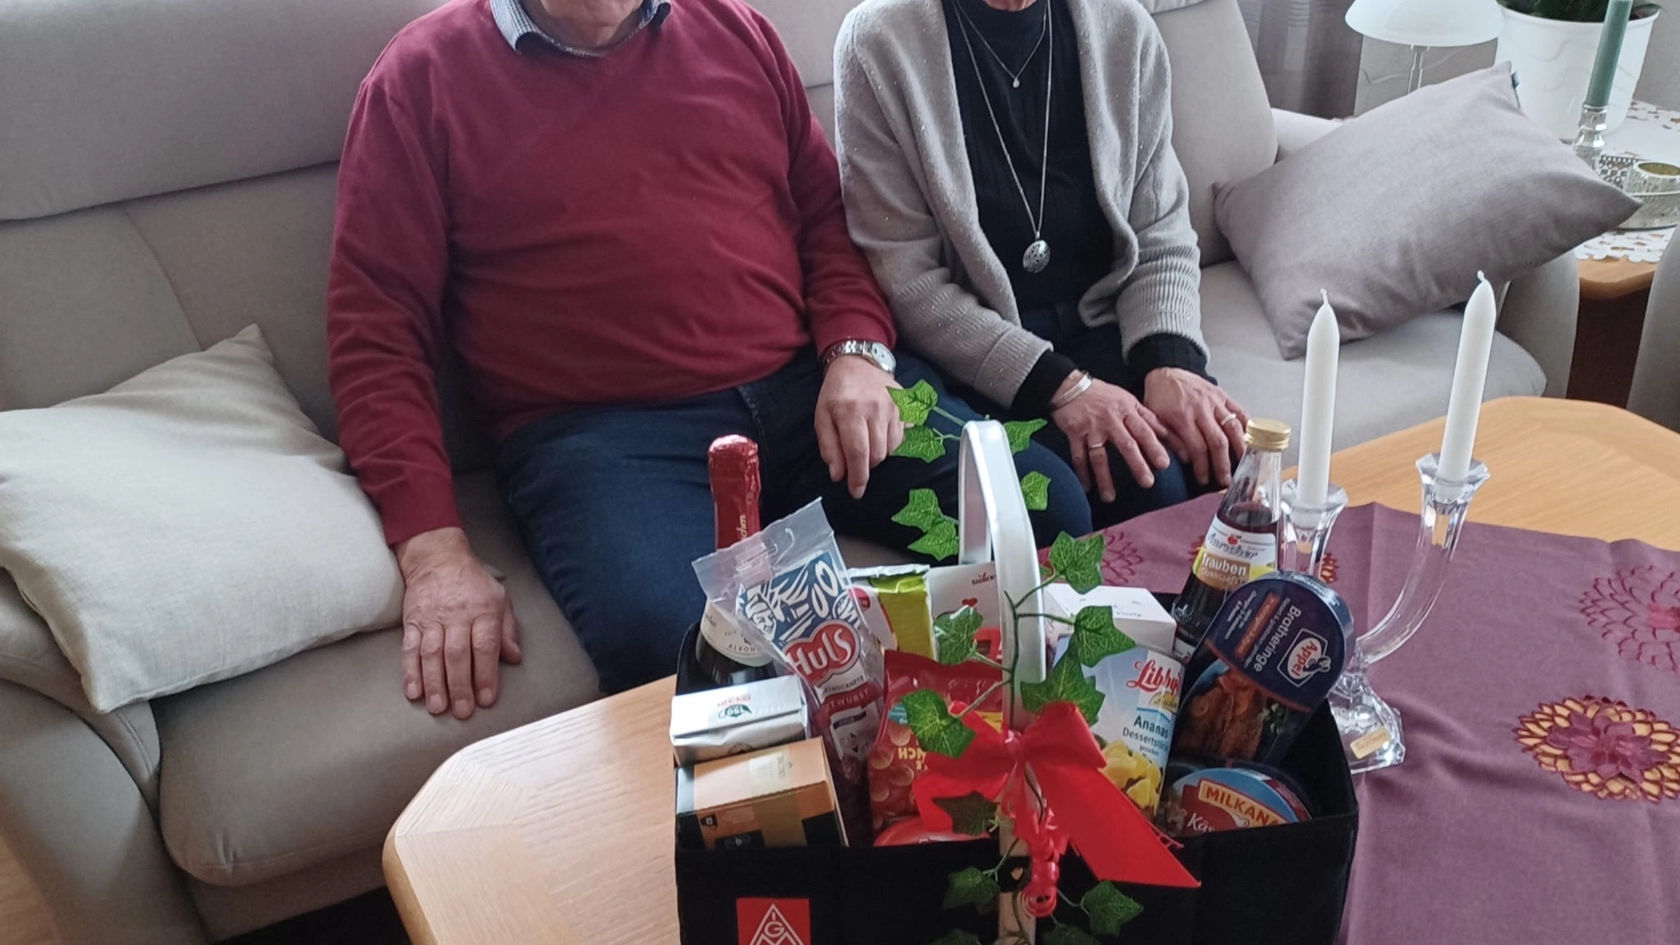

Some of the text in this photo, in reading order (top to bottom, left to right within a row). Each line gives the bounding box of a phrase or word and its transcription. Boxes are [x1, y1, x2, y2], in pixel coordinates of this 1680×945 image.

[1201, 552, 1248, 577] Trauben
[1253, 605, 1302, 673] Bratheringe
[1291, 640, 1319, 677] Appel
[1133, 714, 1169, 740] Ananas
